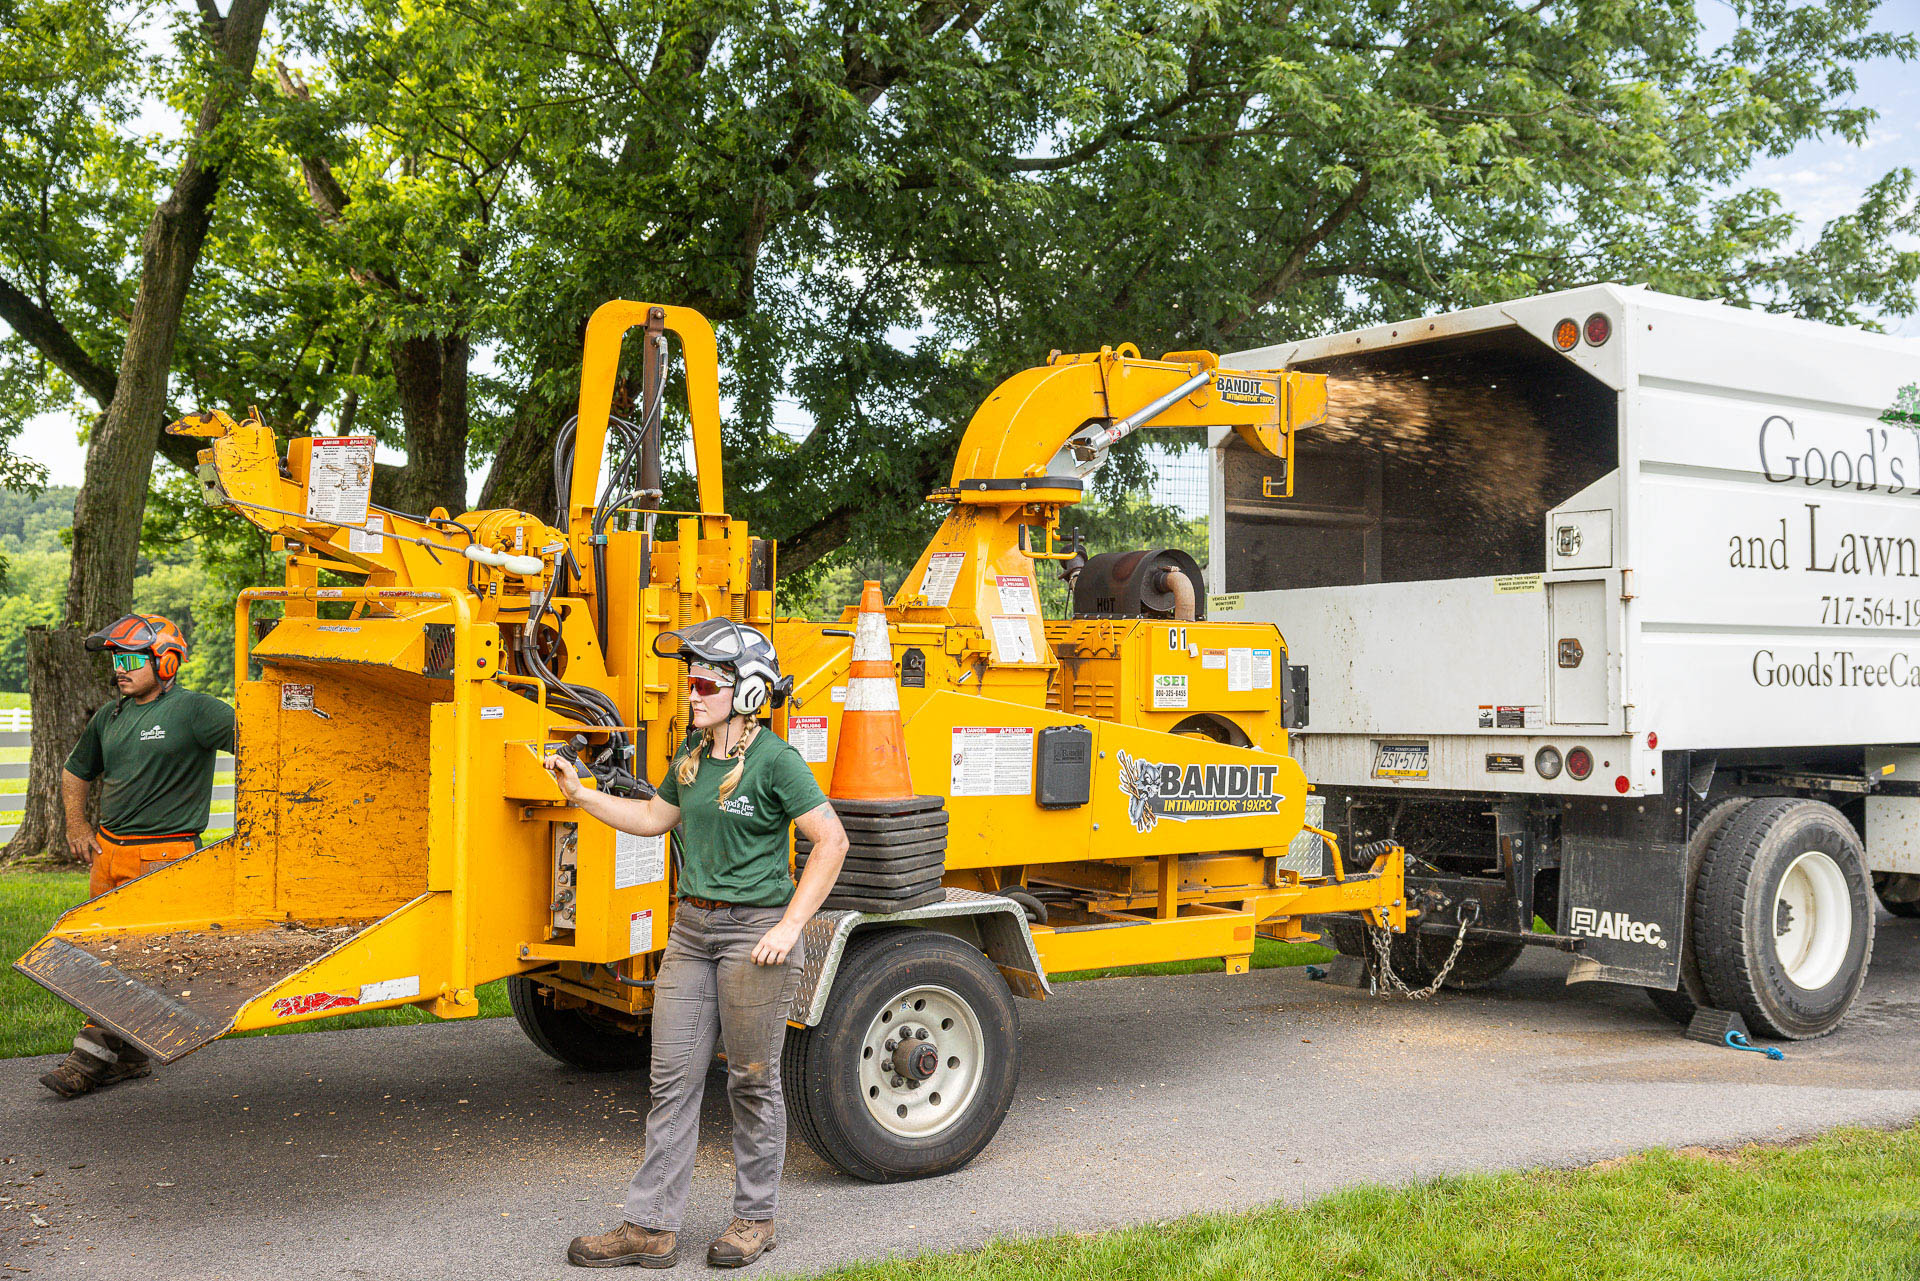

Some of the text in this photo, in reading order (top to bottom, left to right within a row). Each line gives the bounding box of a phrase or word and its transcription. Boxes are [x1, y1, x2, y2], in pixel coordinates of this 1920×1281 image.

[1217, 378, 1261, 394] BANDIT
[1759, 415, 1905, 494] Good's
[1729, 504, 1919, 577] and Lawn
[1097, 597, 1115, 613] HOT
[1752, 649, 1920, 688] GoodsTreeCa
[1163, 676, 1186, 686] SEI
[1159, 765, 1278, 797] BANDIT
[724, 799, 740, 808] ood's
[1242, 800, 1273, 812] 19XPC
